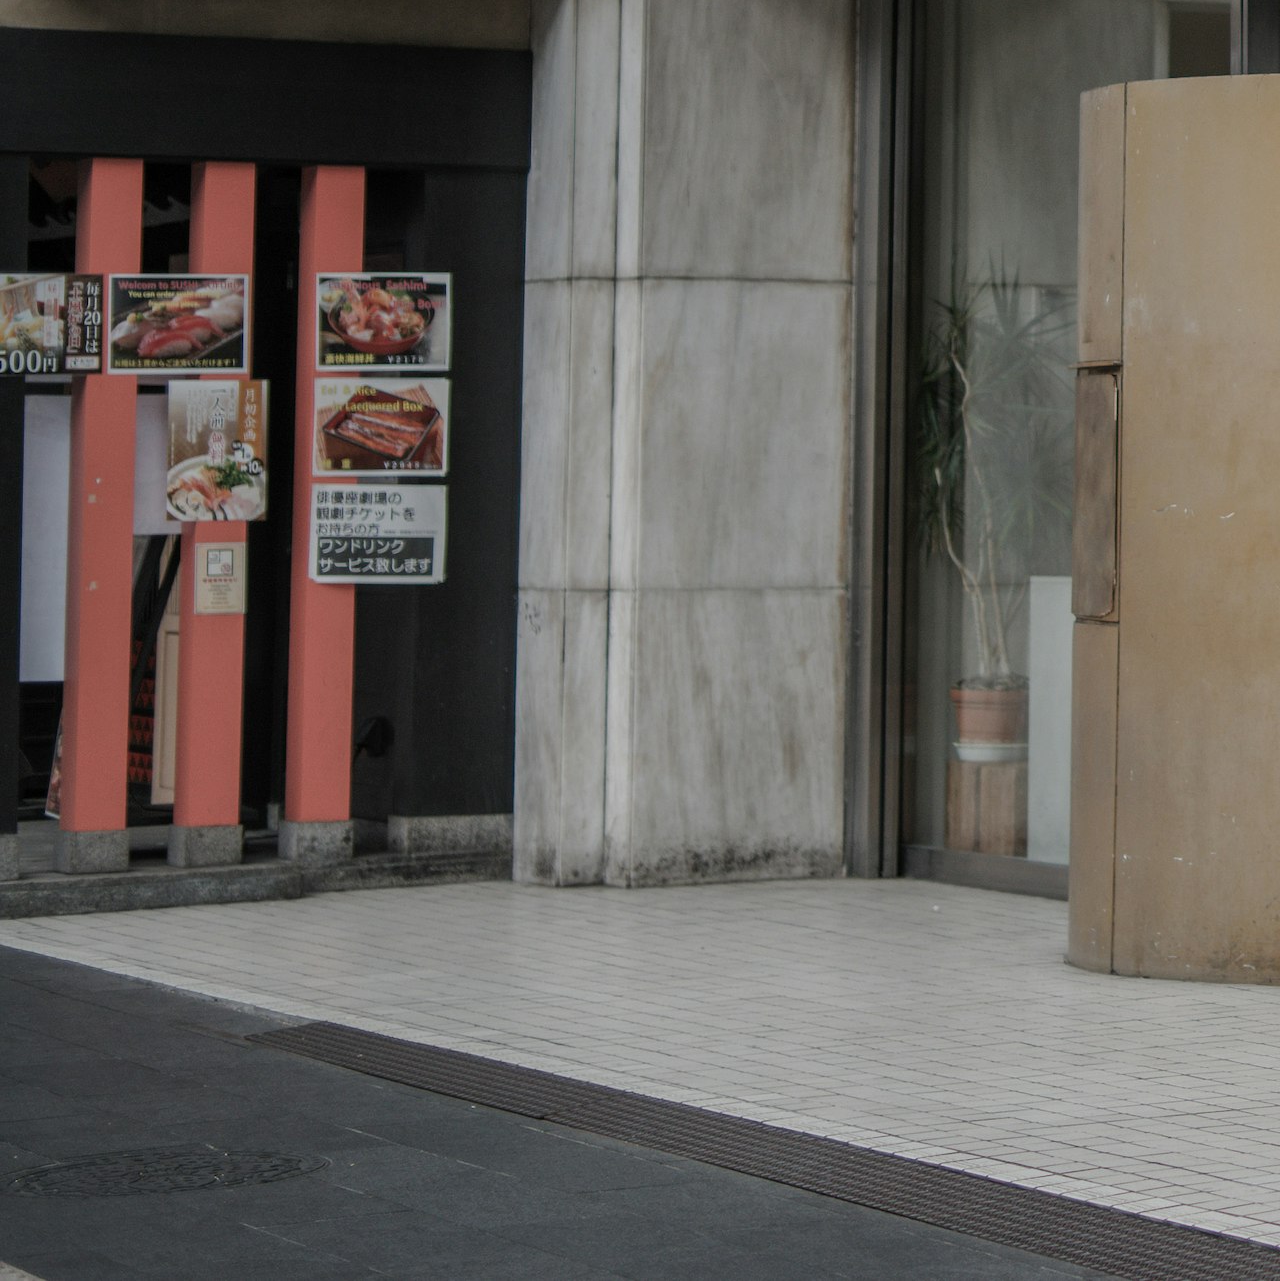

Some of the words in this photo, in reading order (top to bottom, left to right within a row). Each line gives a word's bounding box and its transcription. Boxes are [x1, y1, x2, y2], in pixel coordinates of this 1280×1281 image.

[118, 280, 156, 290] Welcom
[158, 280, 170, 290] to
[385, 279, 427, 291] Sashimi
[128, 290, 142, 298] You
[354, 385, 377, 396] Rice
[345, 401, 400, 412] Lacquered
[402, 400, 424, 412] Box
[316, 490, 402, 505] 俳優座劇場の
[316, 506, 416, 521] 観劇チケットを
[316, 522, 380, 537] お持ちの方
[319, 538, 405, 555] ワンドリンク
[319, 557, 432, 574] サービス致します
